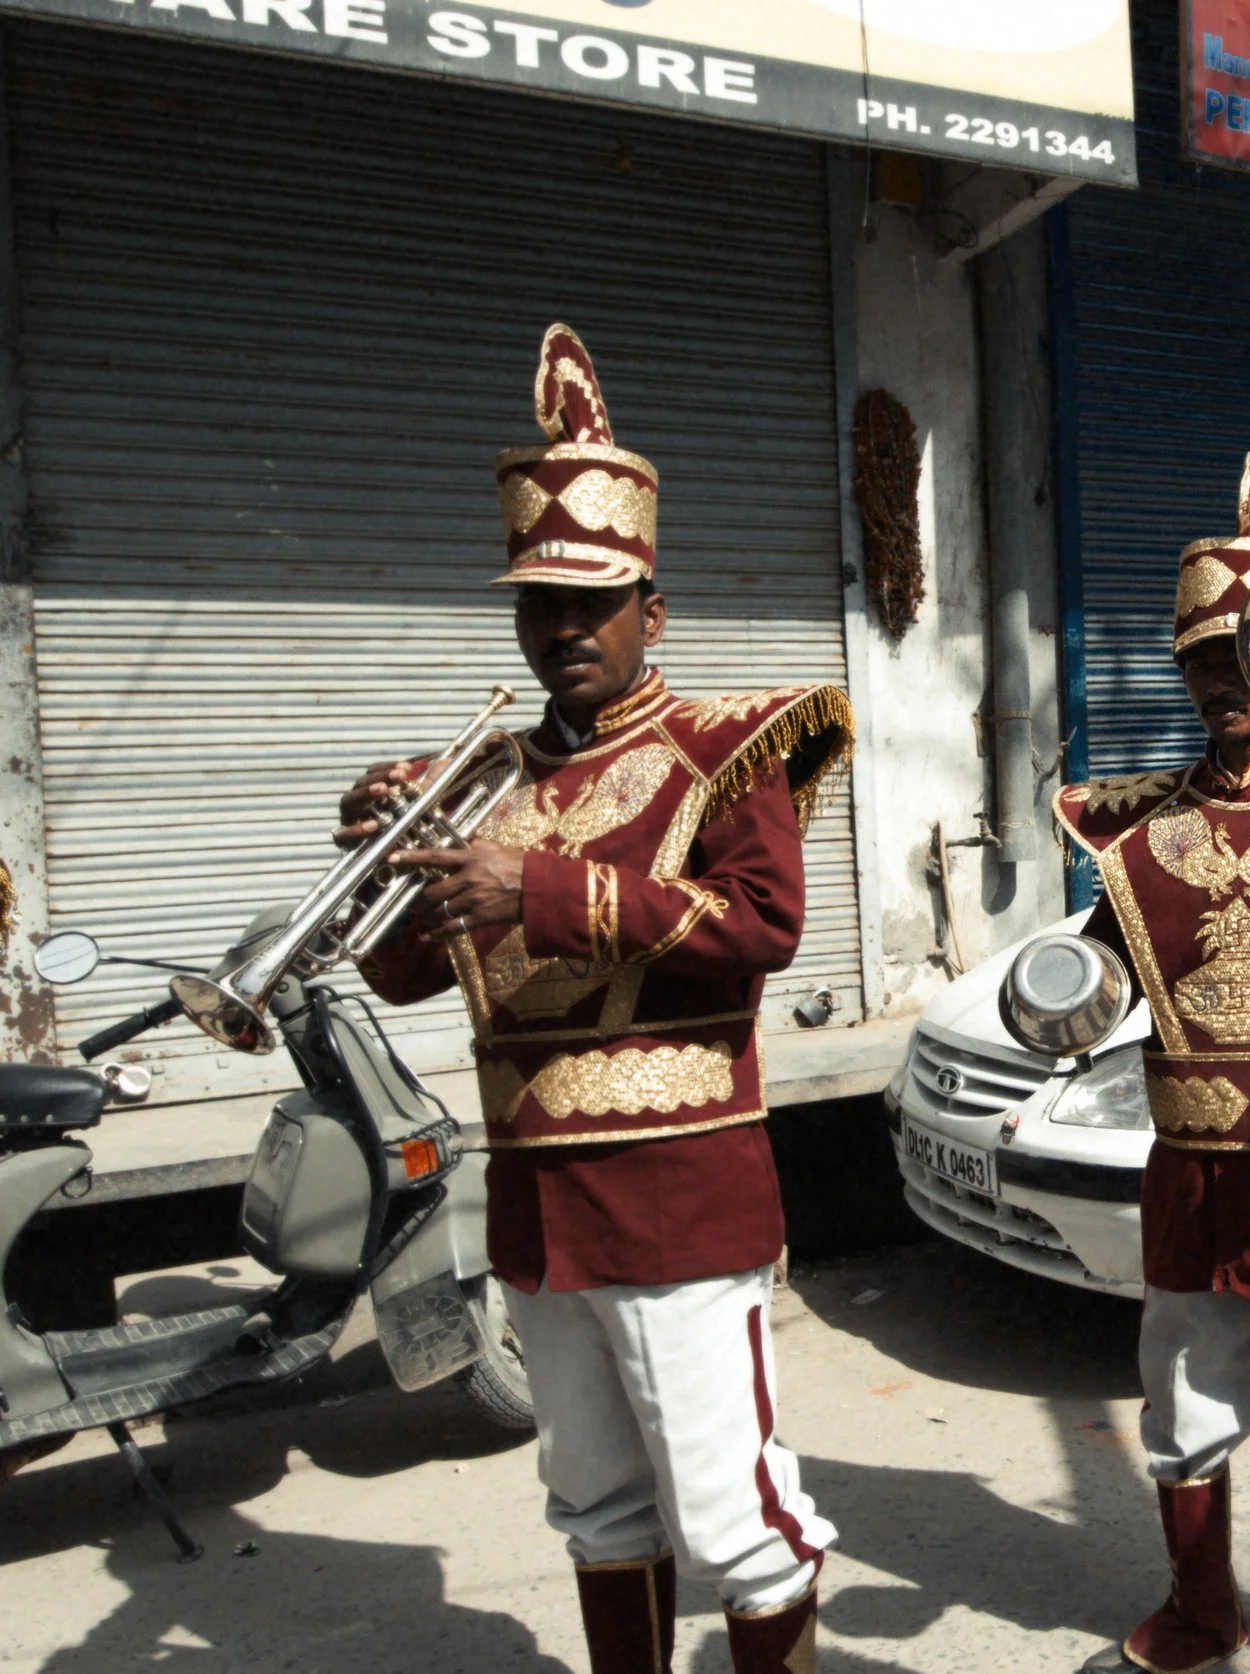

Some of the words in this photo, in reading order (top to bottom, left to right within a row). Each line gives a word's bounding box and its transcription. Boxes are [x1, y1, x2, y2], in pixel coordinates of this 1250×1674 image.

[427, 11, 758, 104] STORE
[857, 98, 931, 134] PH.
[944, 113, 1115, 164] 2291344
[936, 1141, 947, 1172] K
[949, 1147, 985, 1187] 0463
